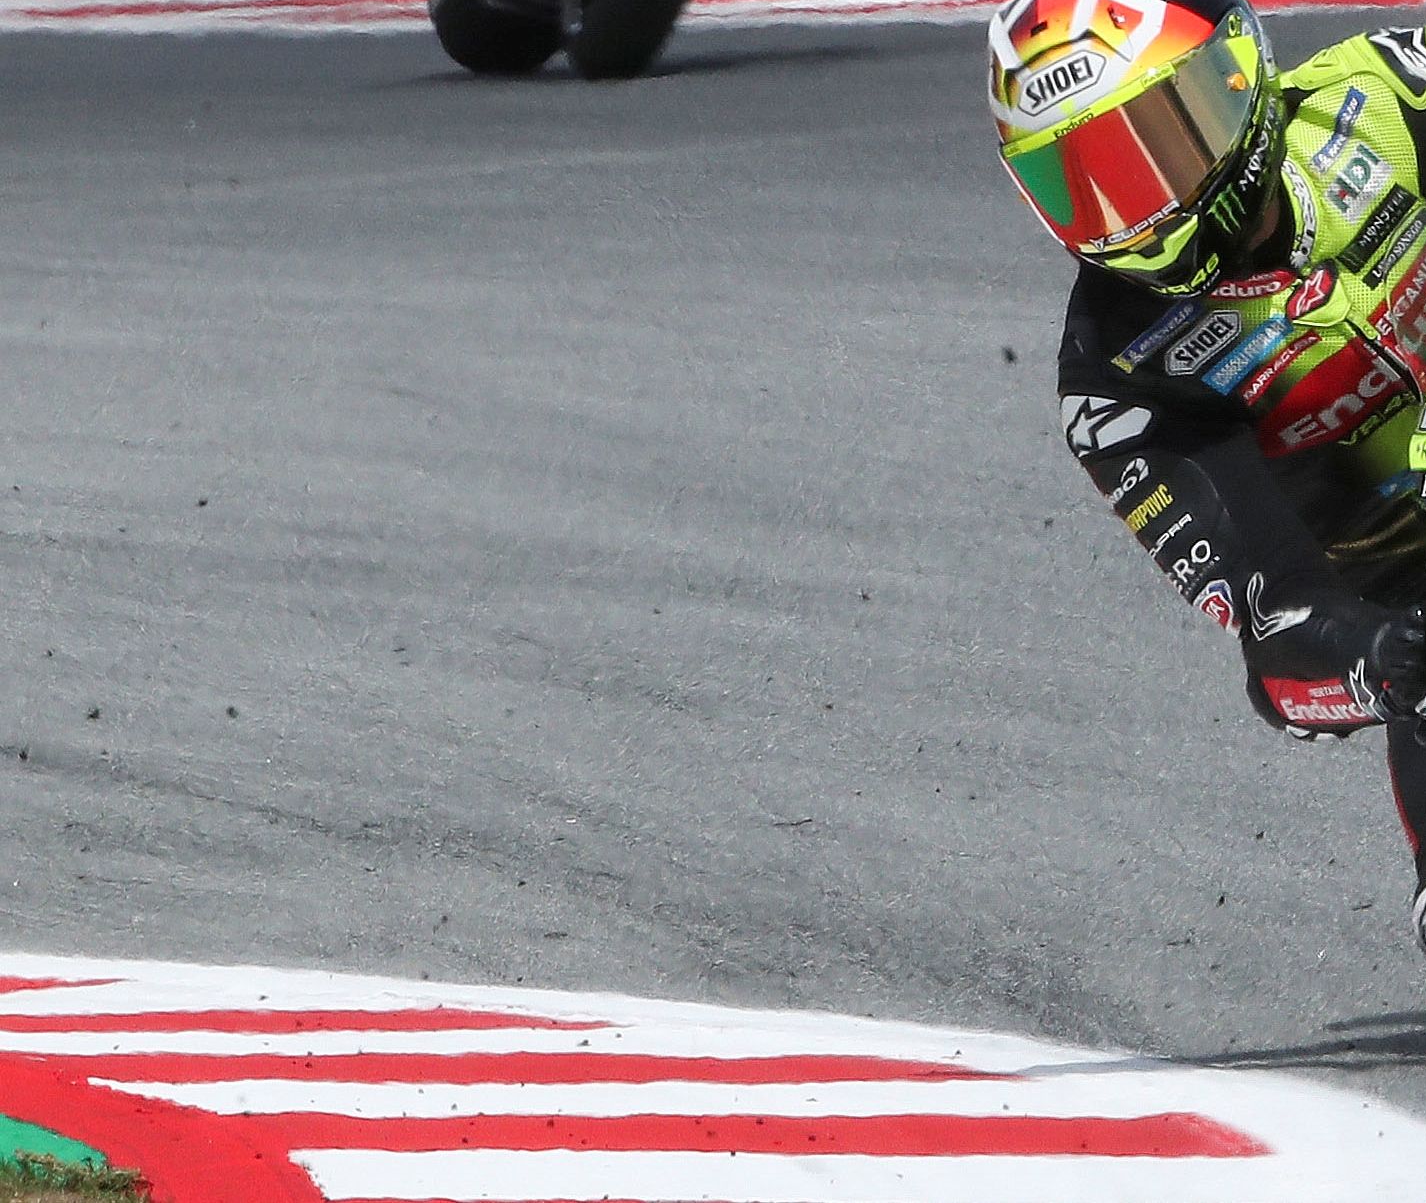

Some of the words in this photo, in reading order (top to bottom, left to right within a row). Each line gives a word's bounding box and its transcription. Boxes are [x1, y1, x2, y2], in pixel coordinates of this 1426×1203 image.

[1025, 55, 1094, 110] SHOEI
[1054, 112, 1094, 139] Enduro
[1107, 199, 1181, 244] CUPRA
[1174, 318, 1234, 367] SHOEI
